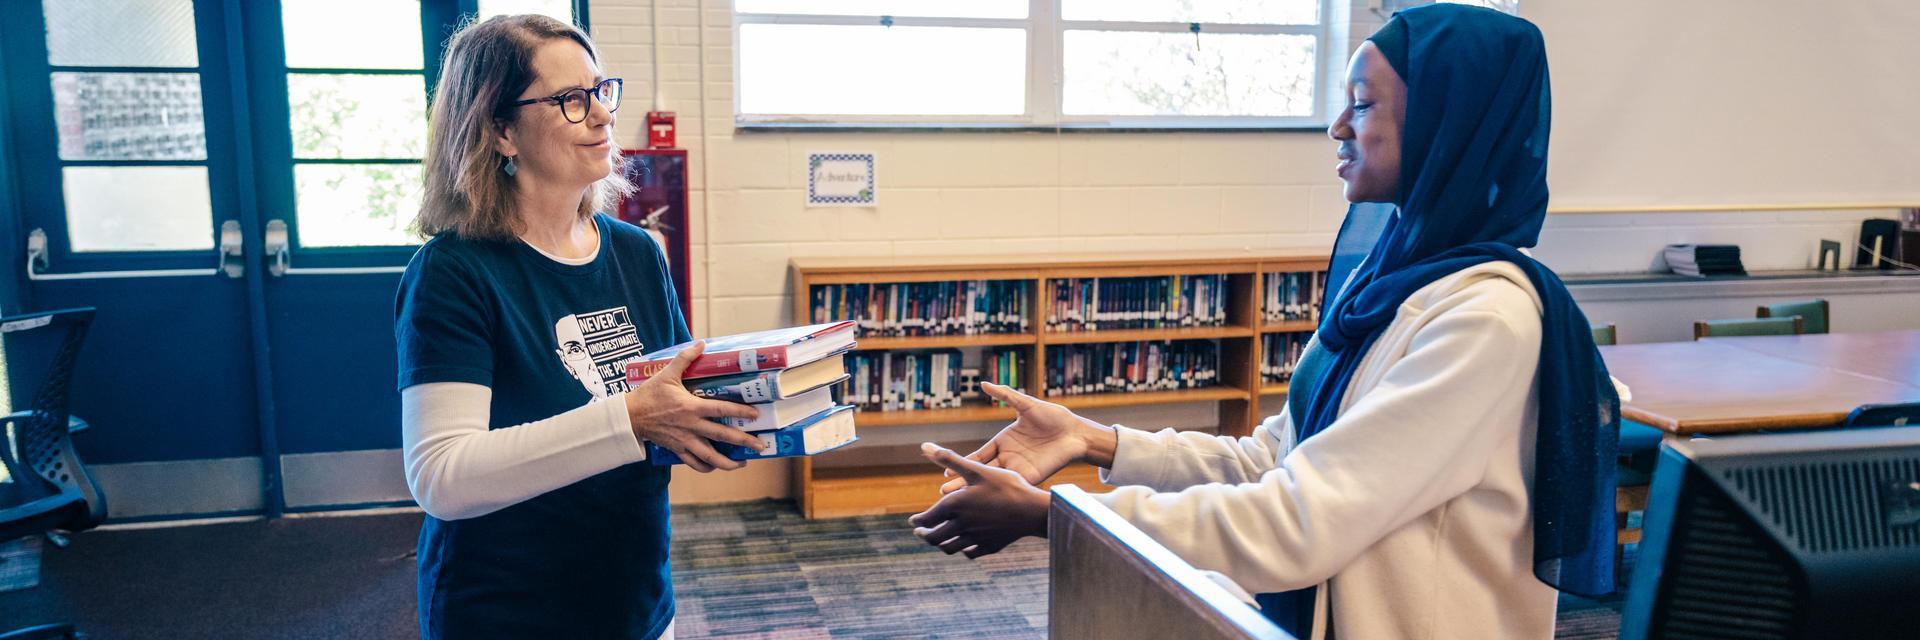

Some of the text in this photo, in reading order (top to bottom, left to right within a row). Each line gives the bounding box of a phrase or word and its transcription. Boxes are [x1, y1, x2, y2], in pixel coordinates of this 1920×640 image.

[578, 313, 615, 333] NEVER
[587, 333, 638, 355] UNDERESTIMATE
[598, 363, 615, 379] THE
